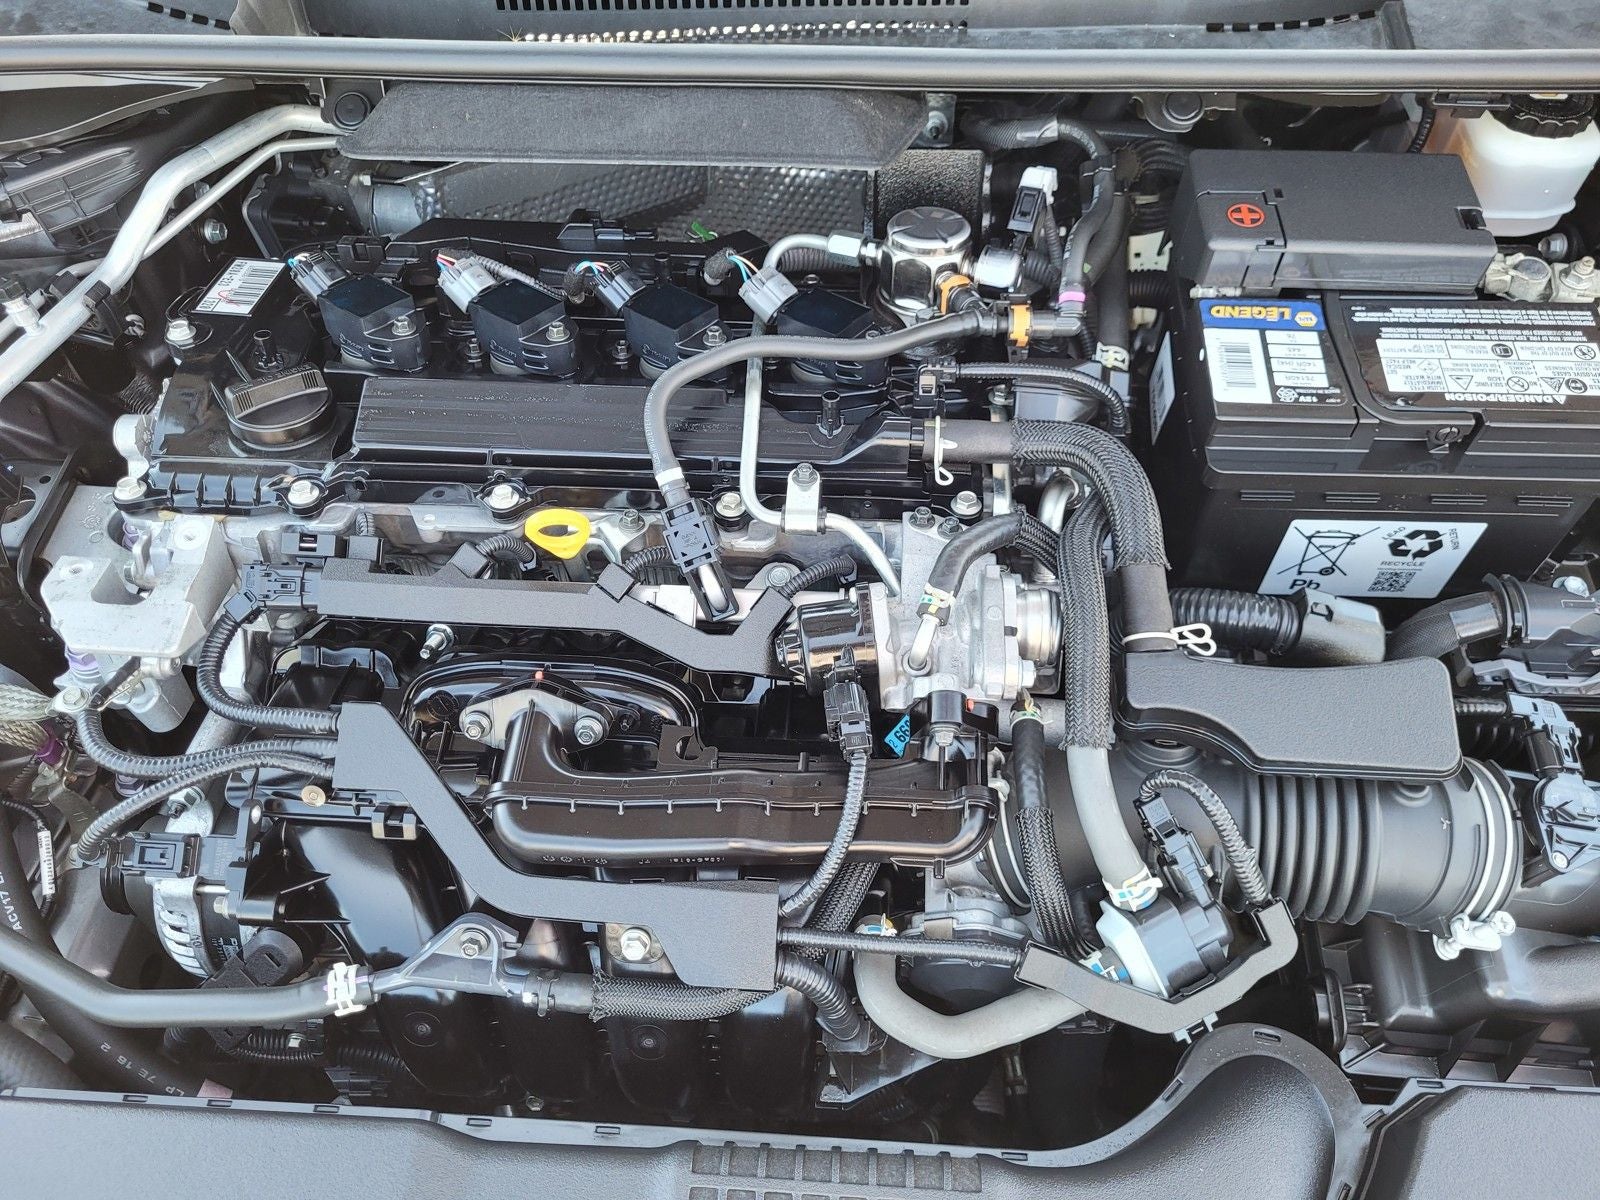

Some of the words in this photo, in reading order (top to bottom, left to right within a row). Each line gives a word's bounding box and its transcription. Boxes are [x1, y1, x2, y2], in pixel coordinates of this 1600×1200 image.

[1210, 305, 1291, 320] LEGEND
[1444, 393, 1554, 402] DANGER/POISON
[1449, 528, 1460, 551] RETURN
[1289, 579, 1321, 590] Pb
[100, 1042, 112, 1053] 2
